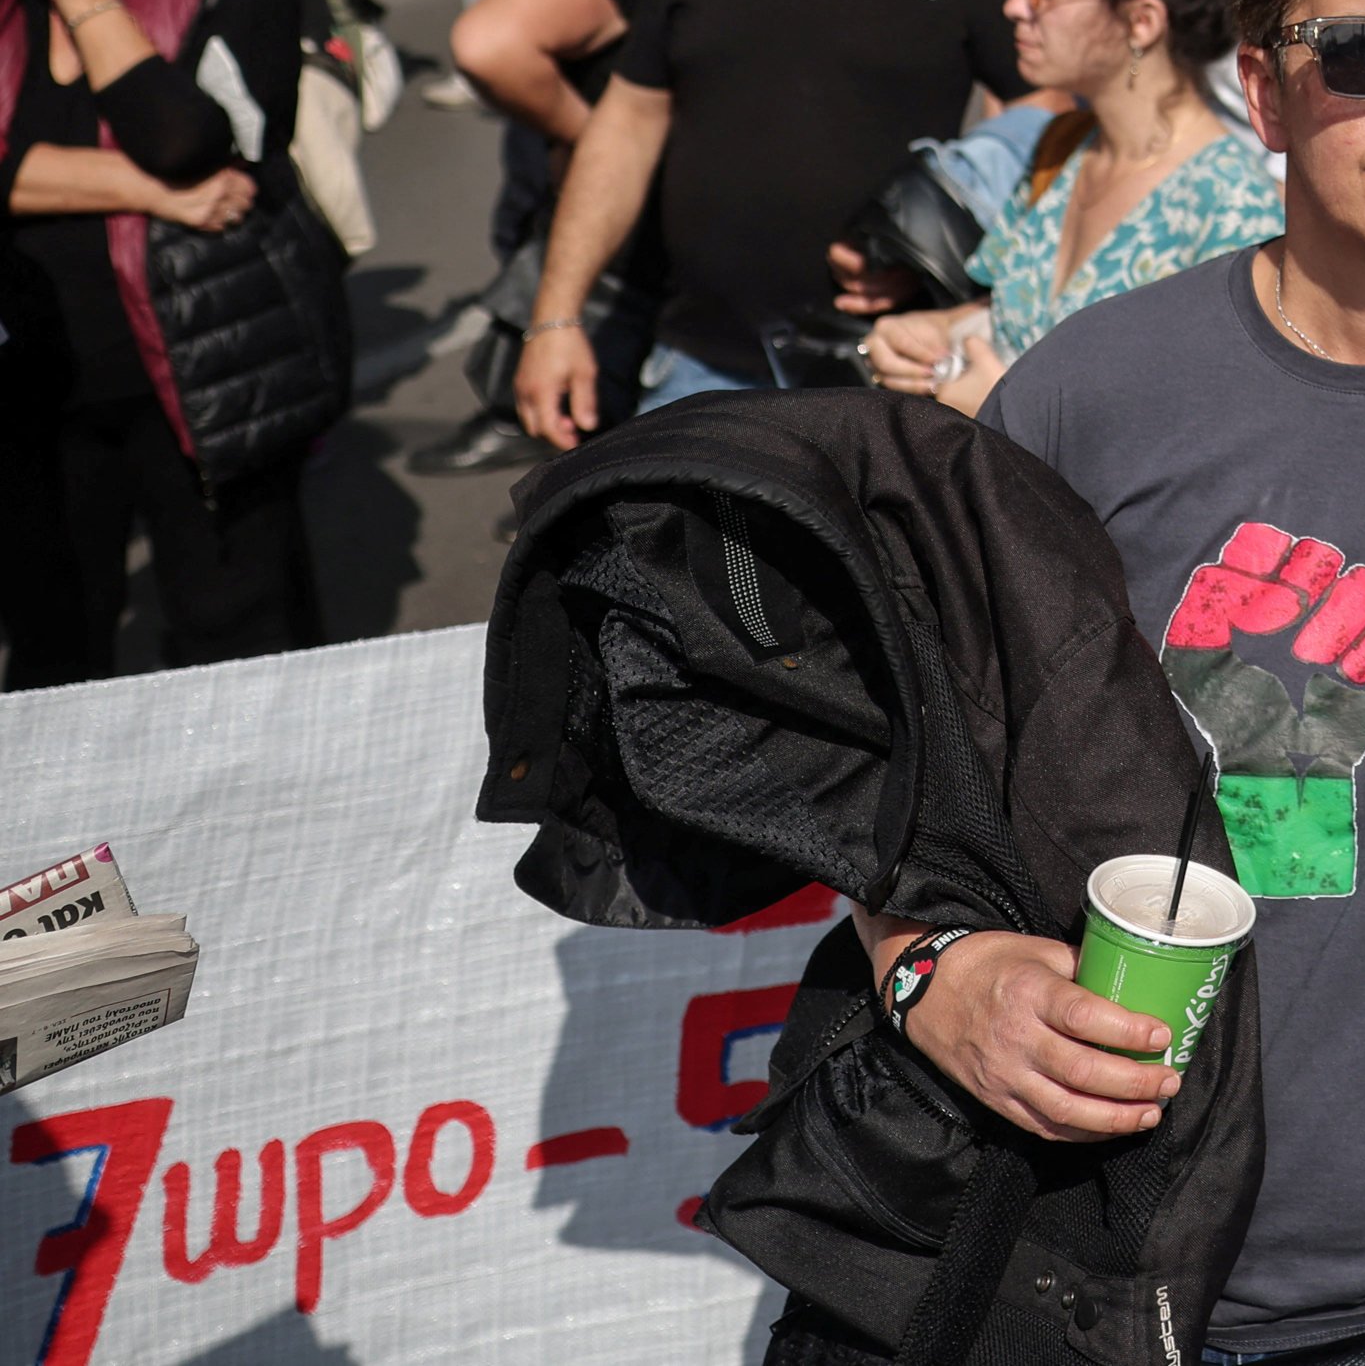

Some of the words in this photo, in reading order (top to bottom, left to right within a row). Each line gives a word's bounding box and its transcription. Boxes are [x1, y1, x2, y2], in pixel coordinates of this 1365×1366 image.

[105, 997, 161, 1018] αποστολή
[138, 1006, 160, 1018] που
[78, 1013, 136, 1038] συνοδεύει
[82, 1015, 102, 1027] του
[44, 1024, 80, 1043] ΠΑΜΕ
[56, 1035, 75, 1048] την
[43, 1042, 110, 1071] καταγράφει
[11, 1096, 496, 1366] 7ωρο
